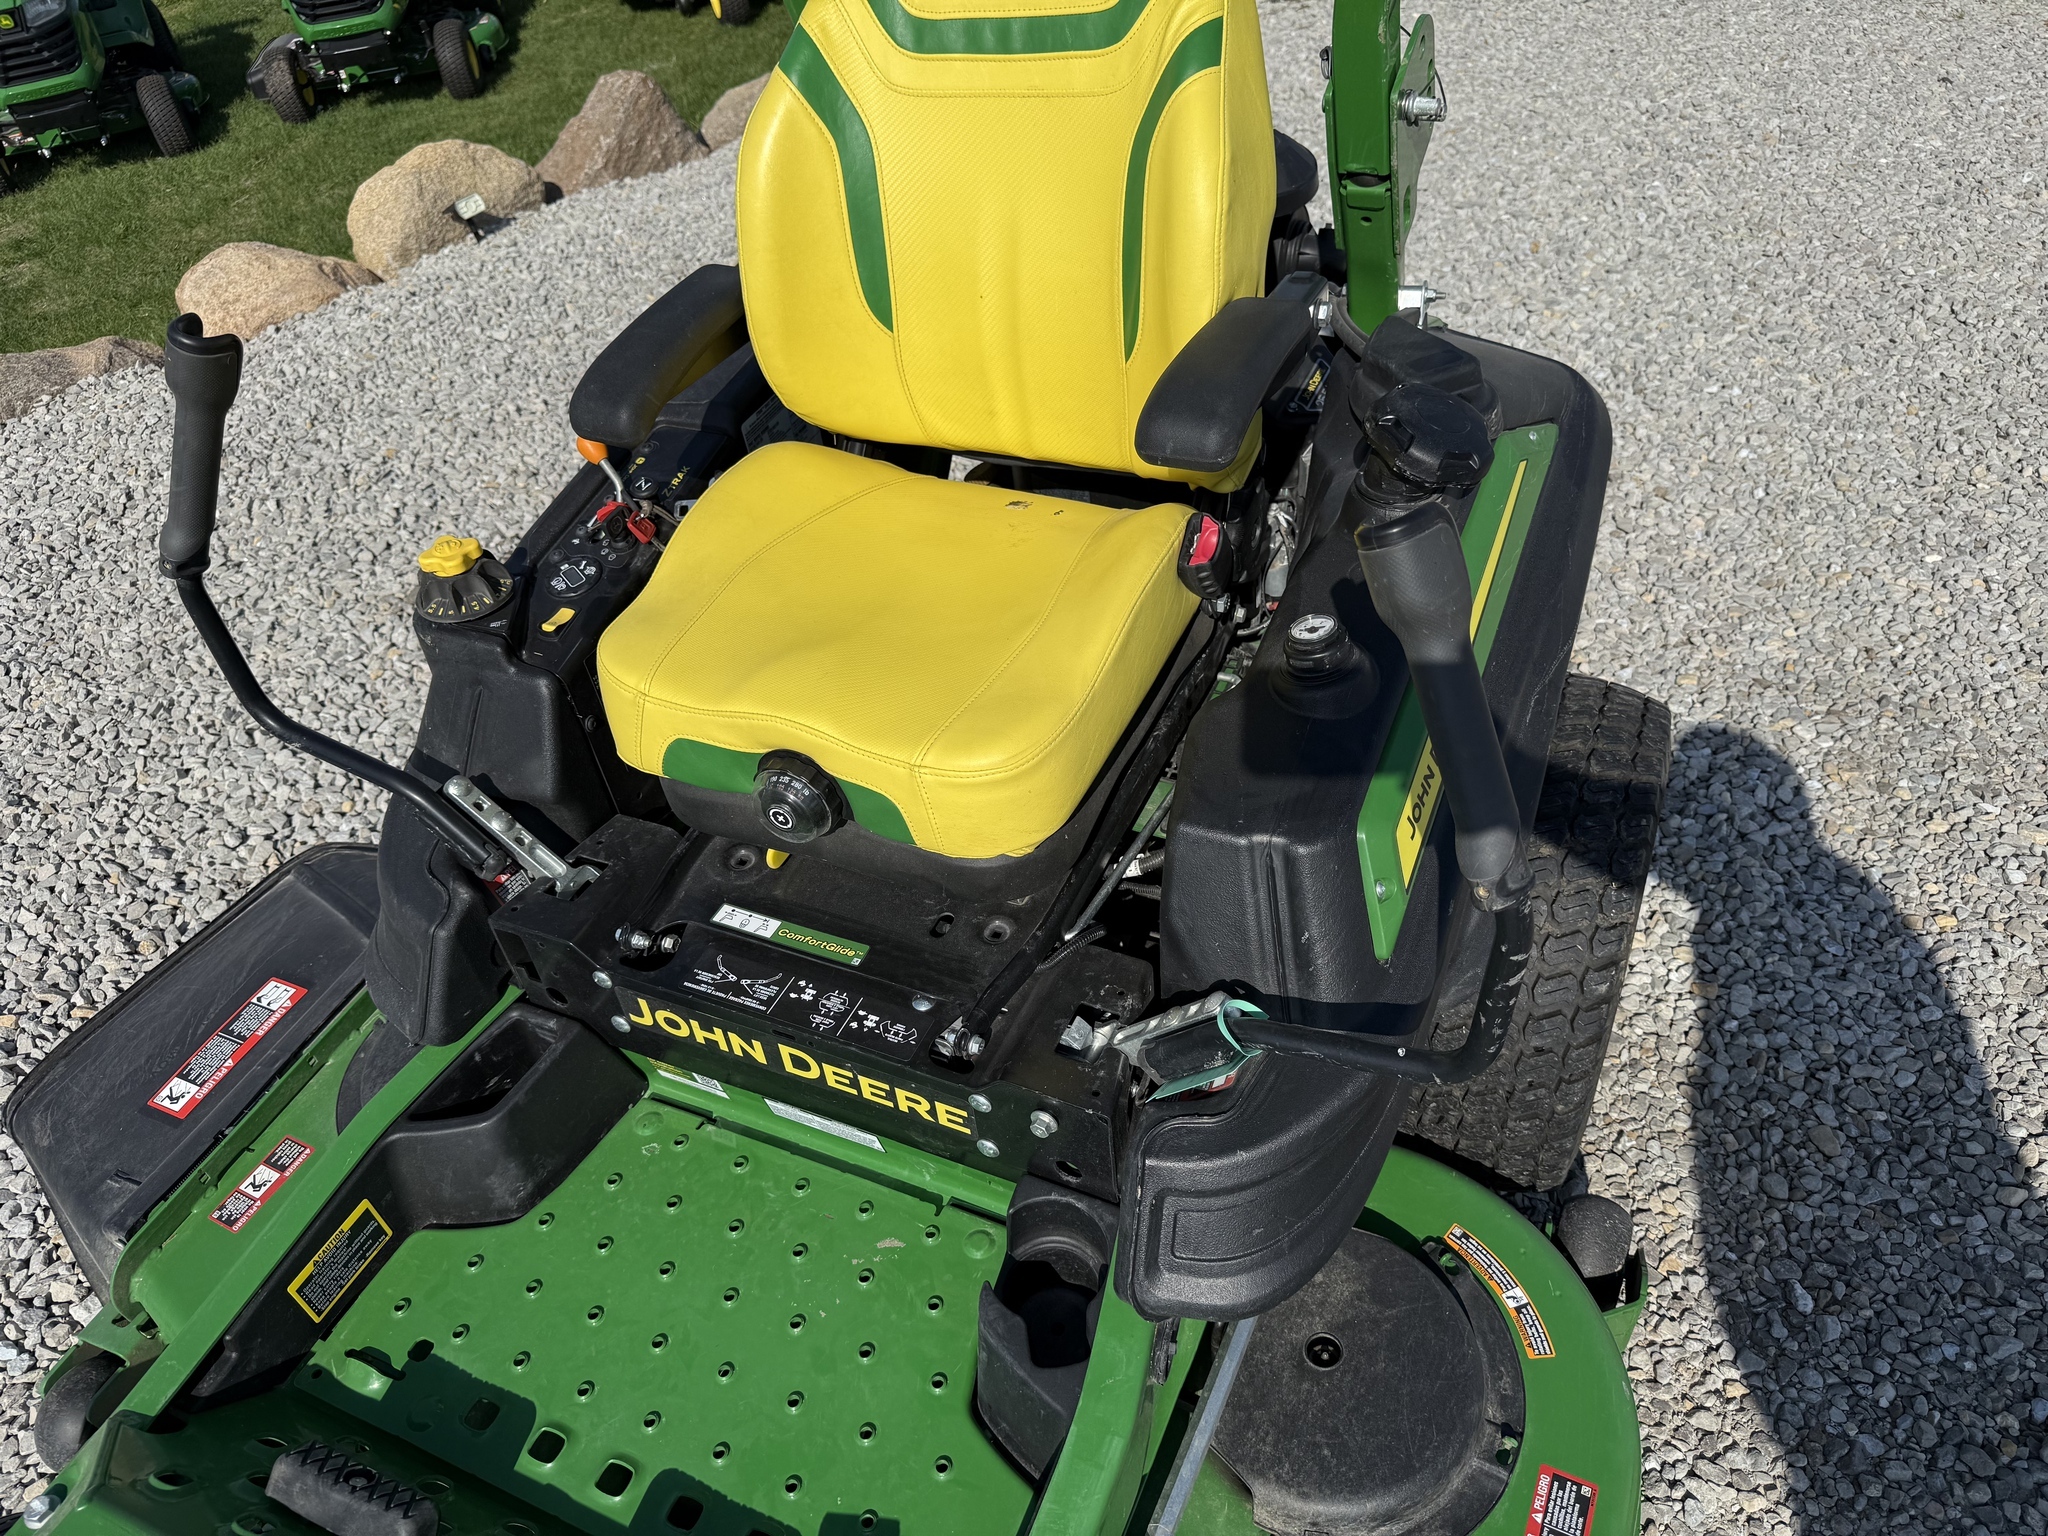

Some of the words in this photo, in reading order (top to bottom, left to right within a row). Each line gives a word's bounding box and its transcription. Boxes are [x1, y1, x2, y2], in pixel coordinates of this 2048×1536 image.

[1407, 764, 1436, 841] JOHN
[253, 1007, 286, 1036] DANGER
[629, 997, 767, 1065] JOHN
[777, 1043, 972, 1134] DEERE
[192, 1066, 228, 1099] PELIGRO
[282, 1152, 307, 1177] DANGER
[231, 1205, 257, 1231] PELIGRO
[312, 1261, 324, 1275] HELP
[323, 1246, 336, 1263] AVOID
[335, 1229, 351, 1248] INJURY
[317, 1227, 345, 1260] CAUTION
[1457, 1246, 1489, 1277] ADVERTENCIA
[1512, 1314, 1531, 1342] WARNING
[1533, 1473, 1550, 1510] PELIGRO
